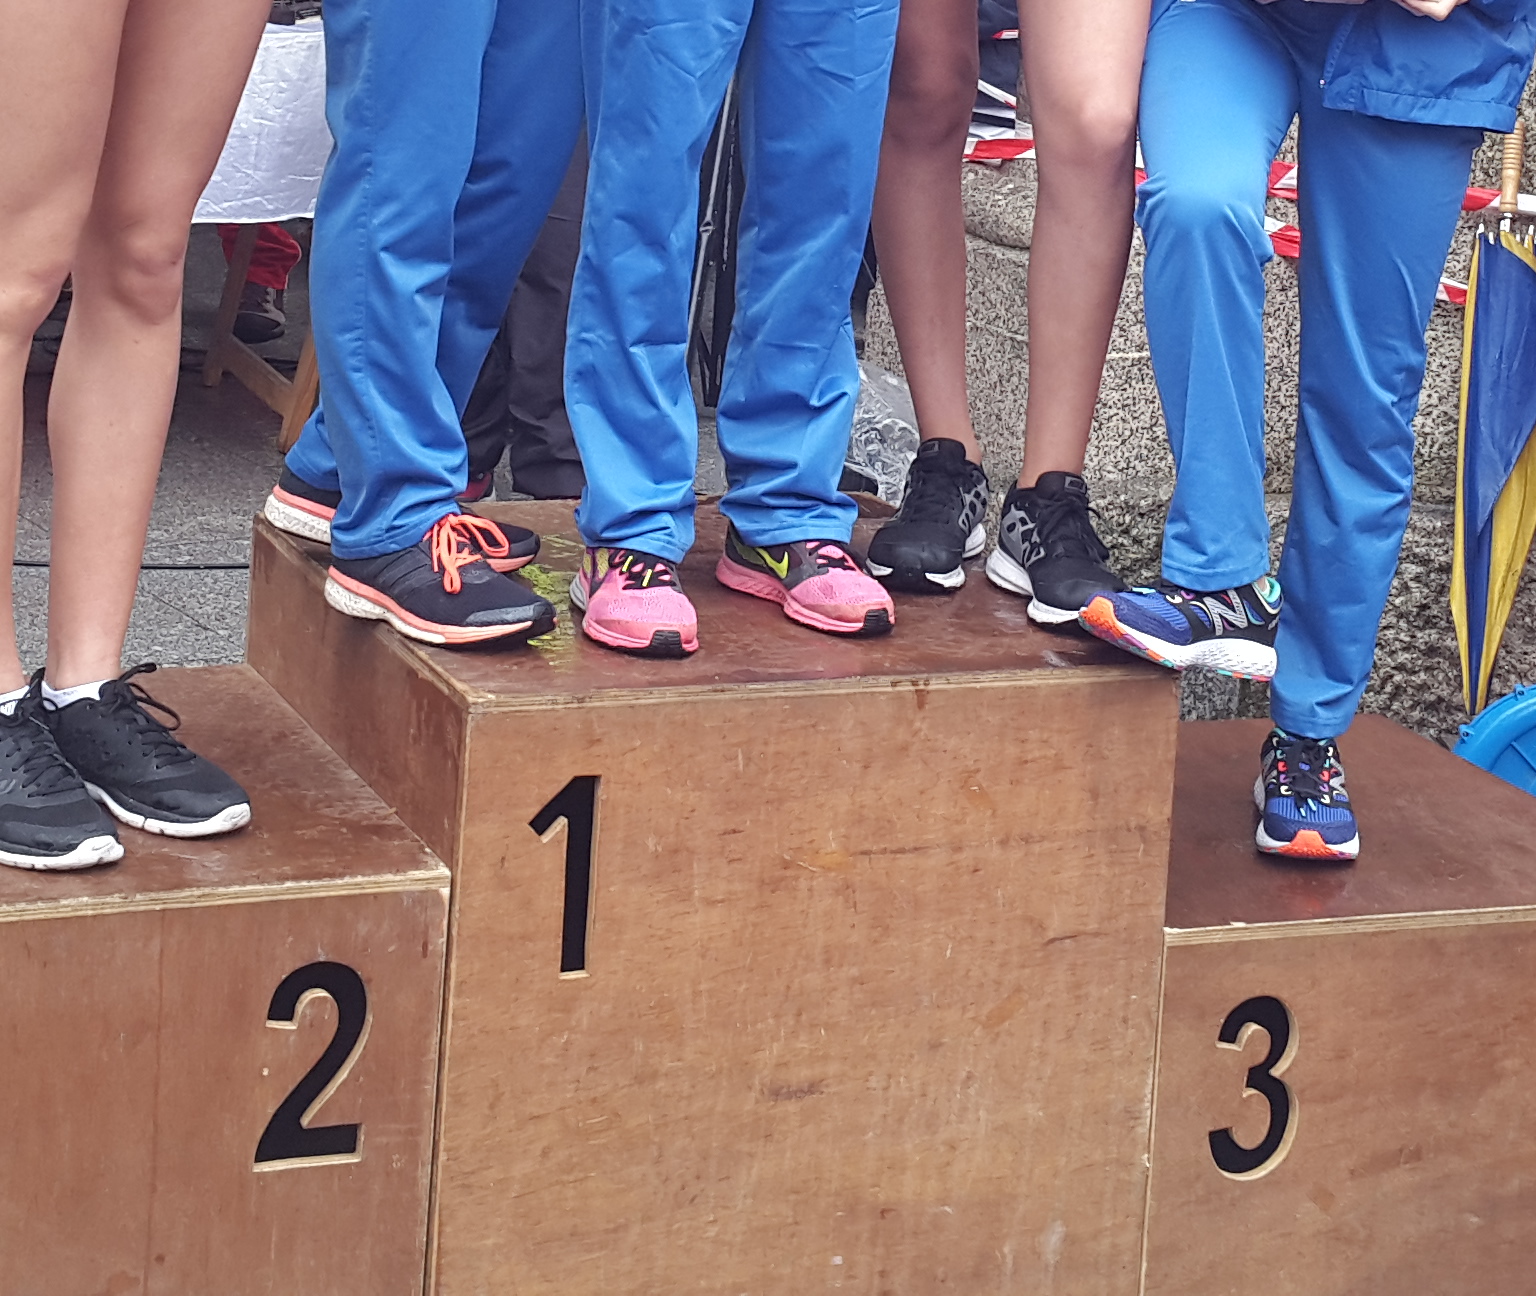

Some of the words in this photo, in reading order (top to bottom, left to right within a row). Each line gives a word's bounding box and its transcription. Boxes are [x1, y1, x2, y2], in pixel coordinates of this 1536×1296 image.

[528, 773, 602, 979] 1
[253, 960, 372, 1172] 2
[1208, 994, 1300, 1181] 3
